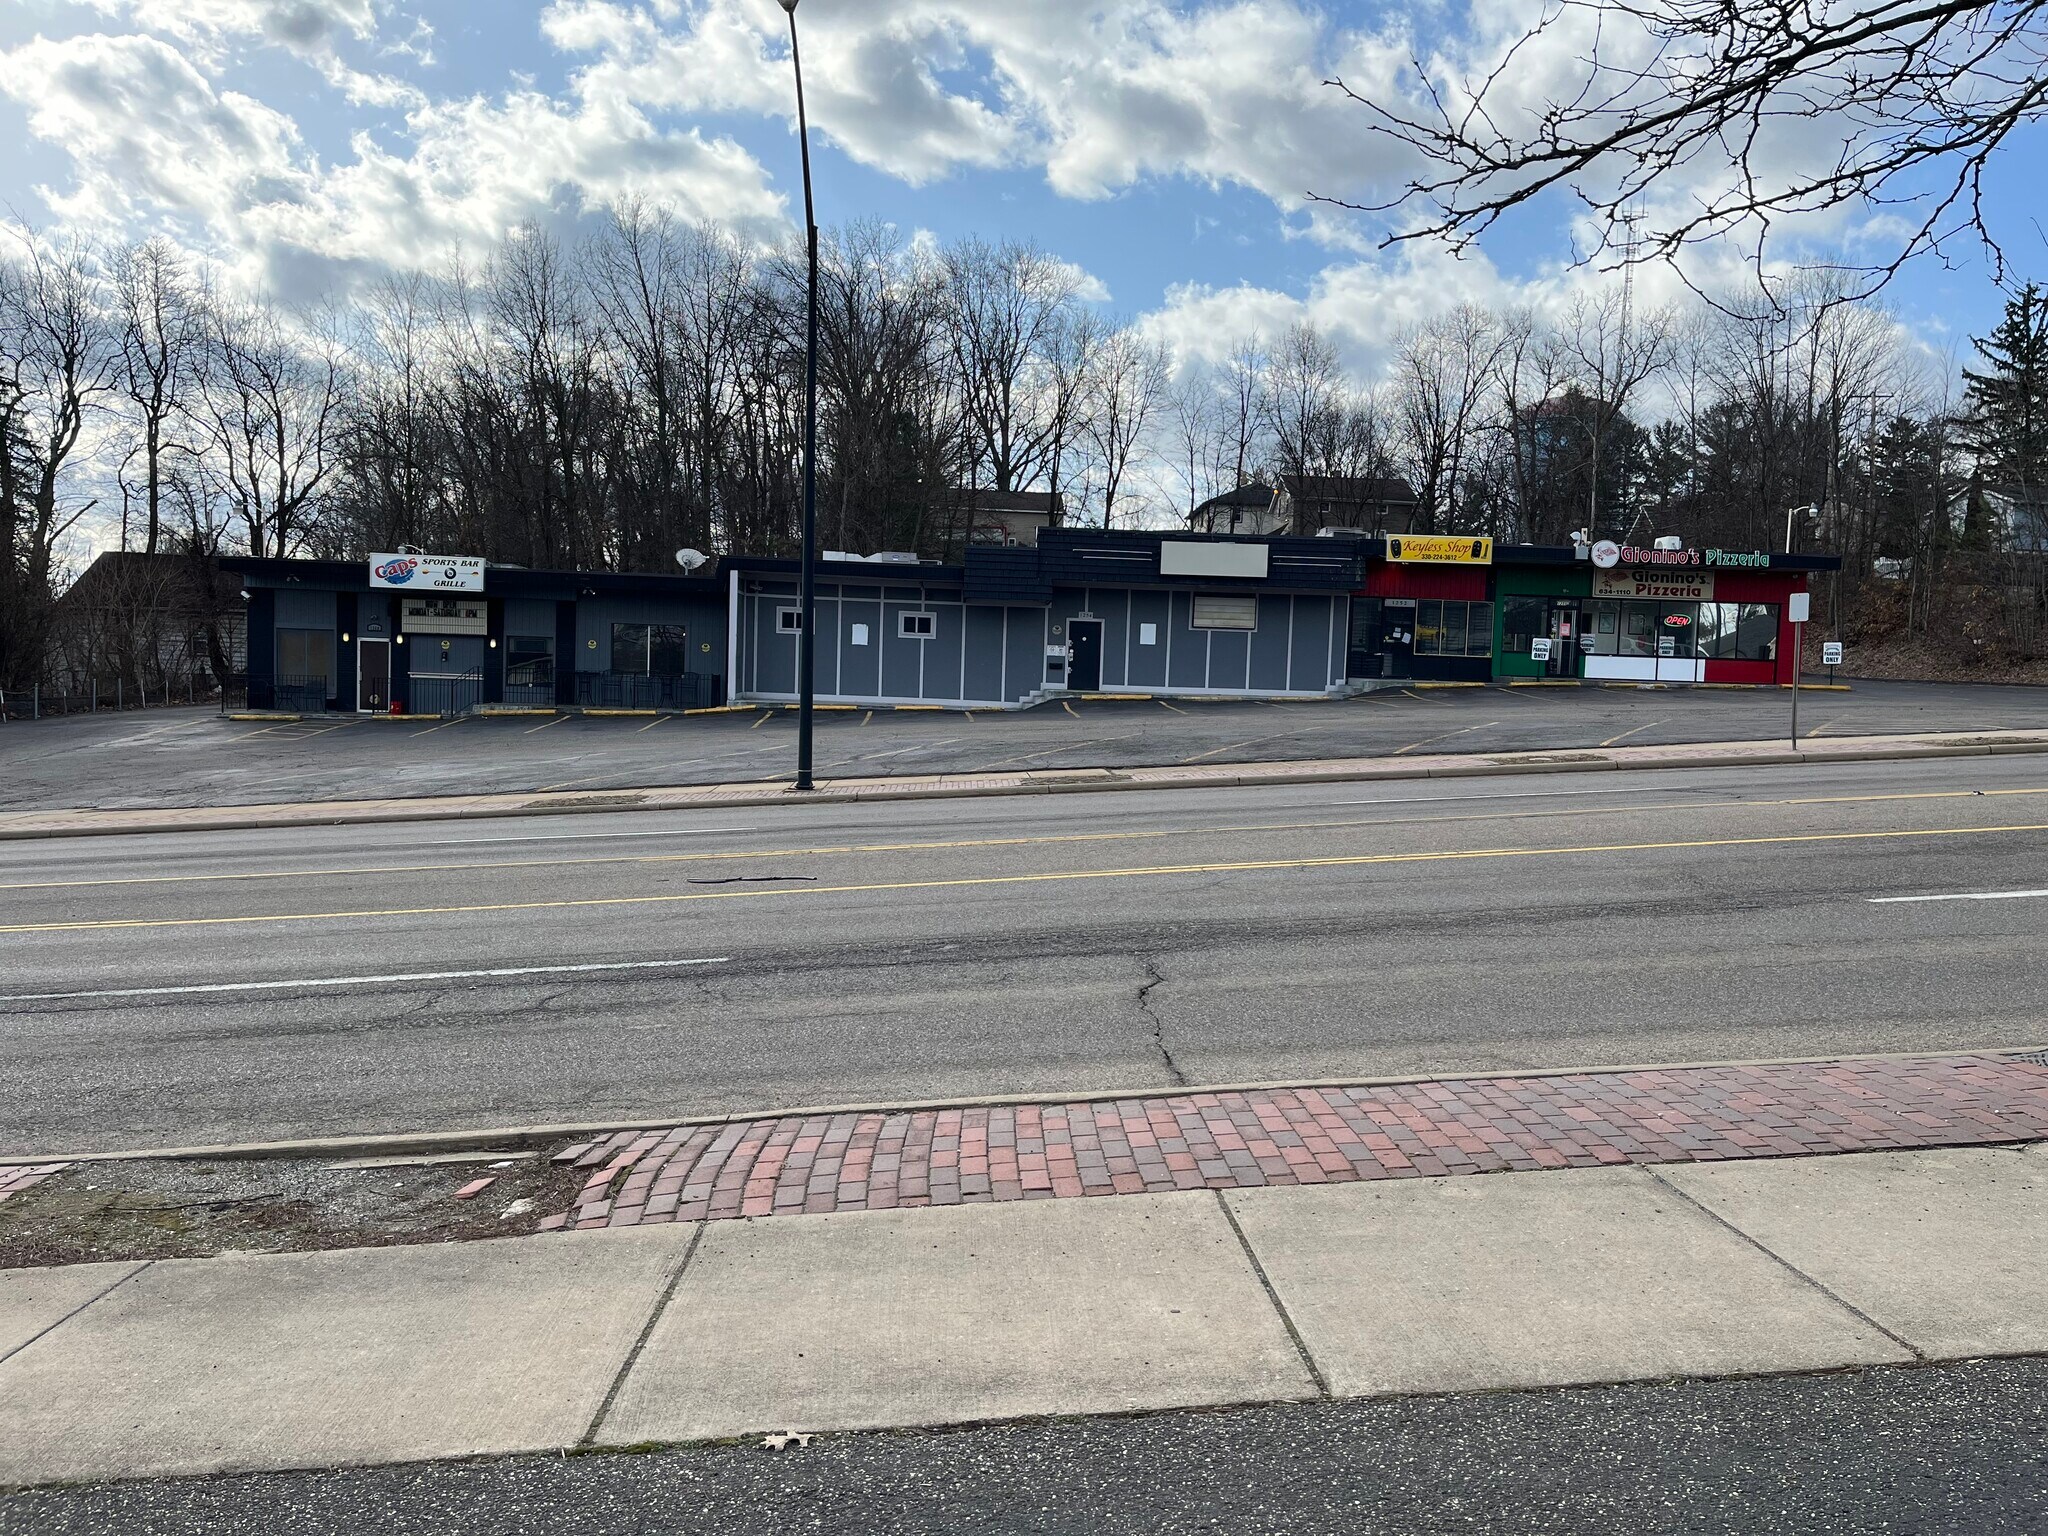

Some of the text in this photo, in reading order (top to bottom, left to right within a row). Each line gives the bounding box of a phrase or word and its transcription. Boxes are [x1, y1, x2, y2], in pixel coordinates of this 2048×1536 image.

[1403, 538, 1471, 558] Keyless Shop
[422, 558, 457, 567] SPORTS
[1620, 546, 1700, 565] Gionino's
[1705, 549, 1770, 567] Pizzeria
[375, 558, 418, 579] Caps
[434, 580, 466, 588] GRILLE
[1631, 570, 1706, 585] Gionino's
[1635, 583, 1702, 597] Pizzeria
[1666, 615, 1689, 626] OPEN
